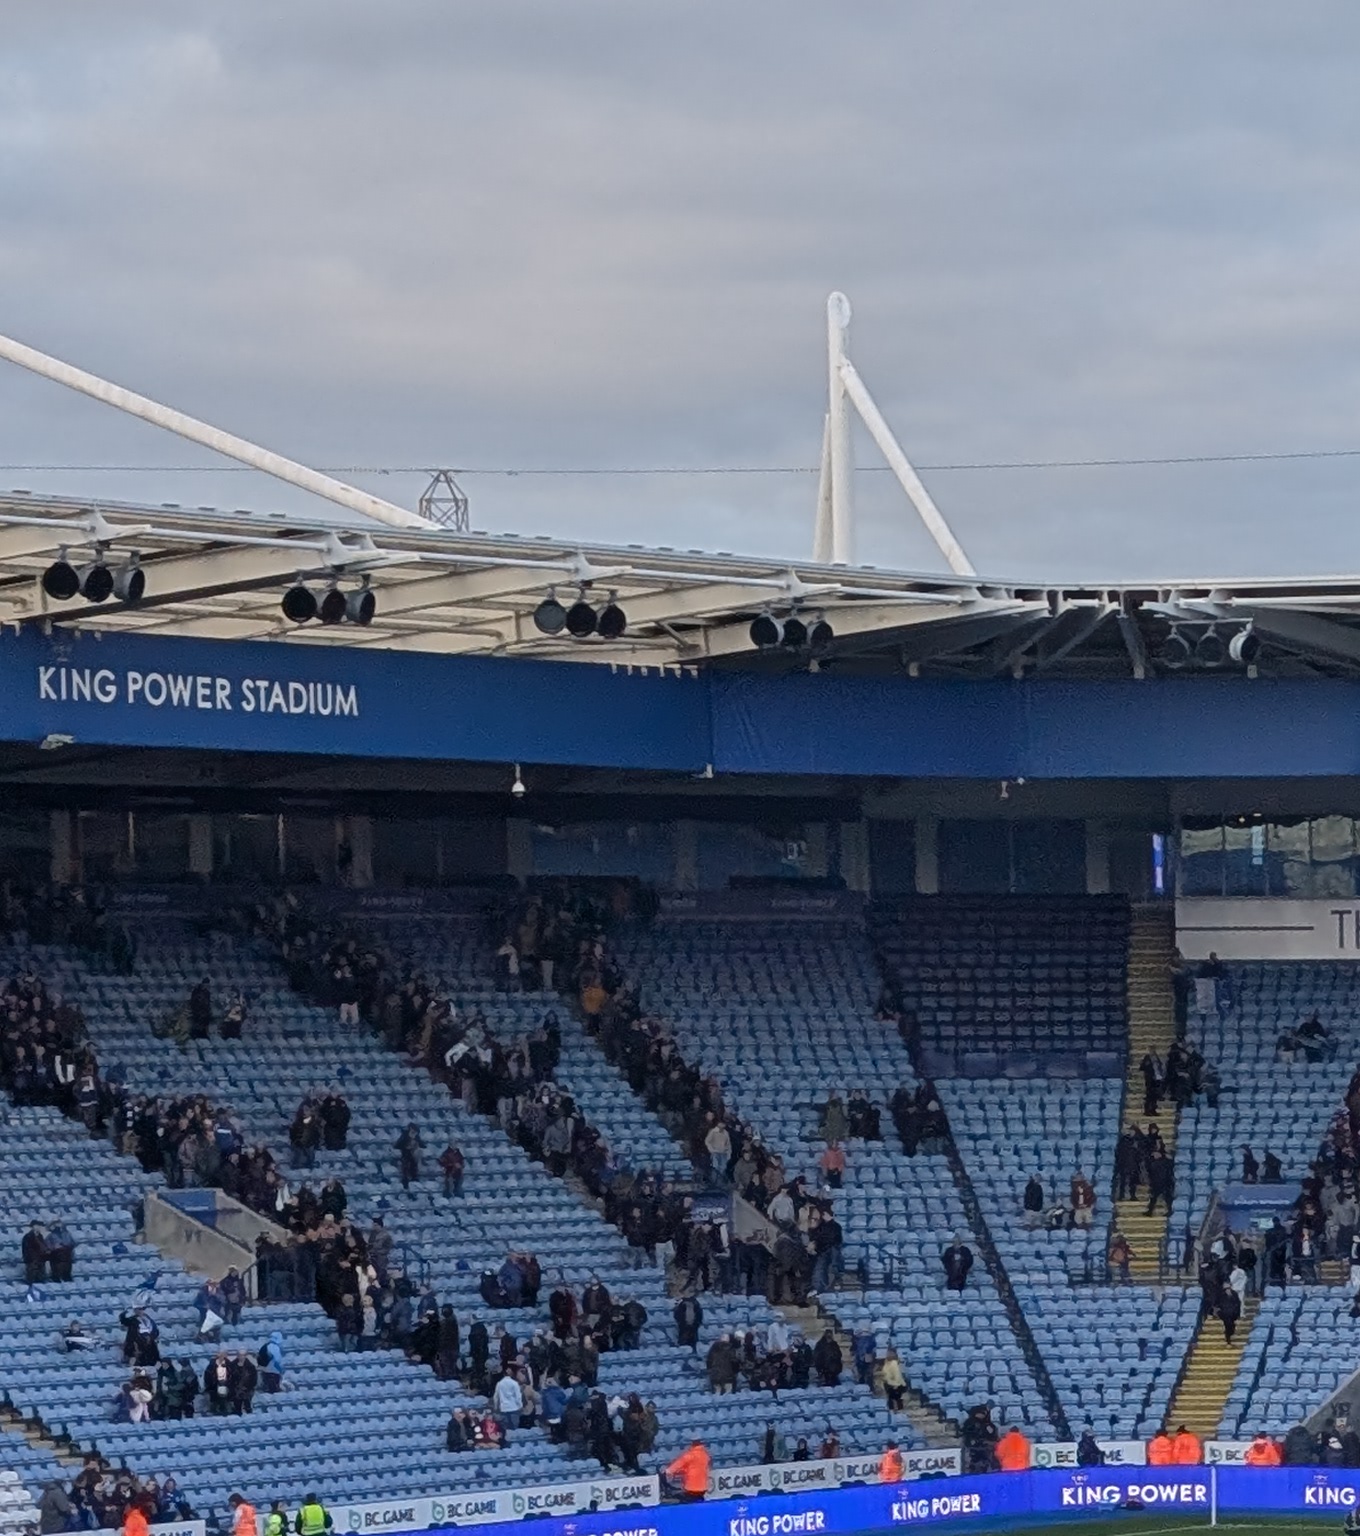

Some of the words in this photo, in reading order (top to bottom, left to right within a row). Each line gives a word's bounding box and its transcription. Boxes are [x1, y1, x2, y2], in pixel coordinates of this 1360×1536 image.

[39, 666, 117, 703] KING
[127, 671, 232, 710] POWER
[241, 678, 359, 717] STADIUM
[909, 1456, 956, 1472] BC.GAME
[718, 1473, 762, 1490] BC.GAME
[527, 1491, 576, 1510] BC.GAME
[605, 1484, 652, 1502] BC.GAME
[1062, 1485, 1121, 1506] KING
[1126, 1484, 1207, 1502] POWER
[1304, 1487, 1356, 1506] KING
[447, 1499, 497, 1518] BC.GAME
[892, 1498, 929, 1520] KING
[932, 1493, 981, 1514] POWER
[365, 1508, 416, 1527] BC.GAME
[773, 1511, 826, 1534] POWER
